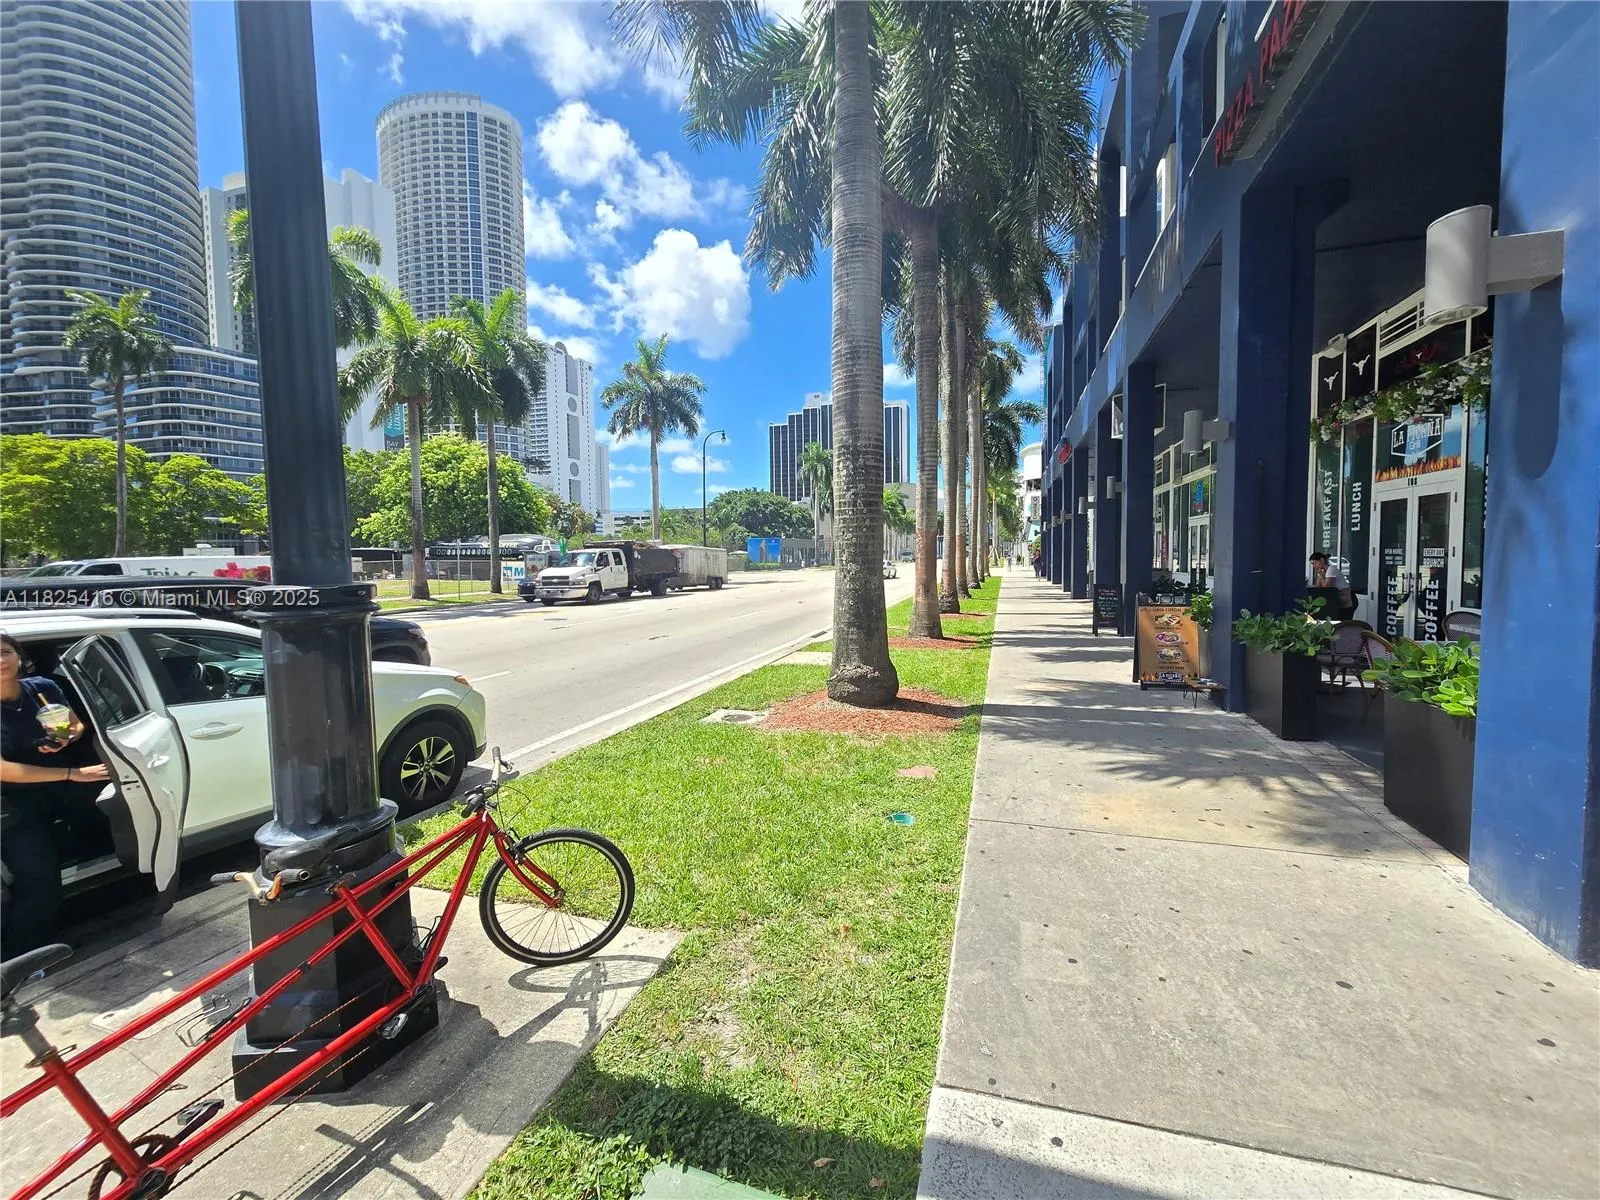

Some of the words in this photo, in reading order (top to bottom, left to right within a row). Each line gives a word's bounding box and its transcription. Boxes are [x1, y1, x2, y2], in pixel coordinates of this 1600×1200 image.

[1215, 69, 1253, 168] PIZZA
[1393, 431, 1405, 448] LA
[1322, 470, 1333, 548] BREAKFAST
[1351, 481, 1362, 531] LUNCH
[1386, 575, 1398, 636] COFFEE
[1424, 579, 1439, 642] COFFEE
